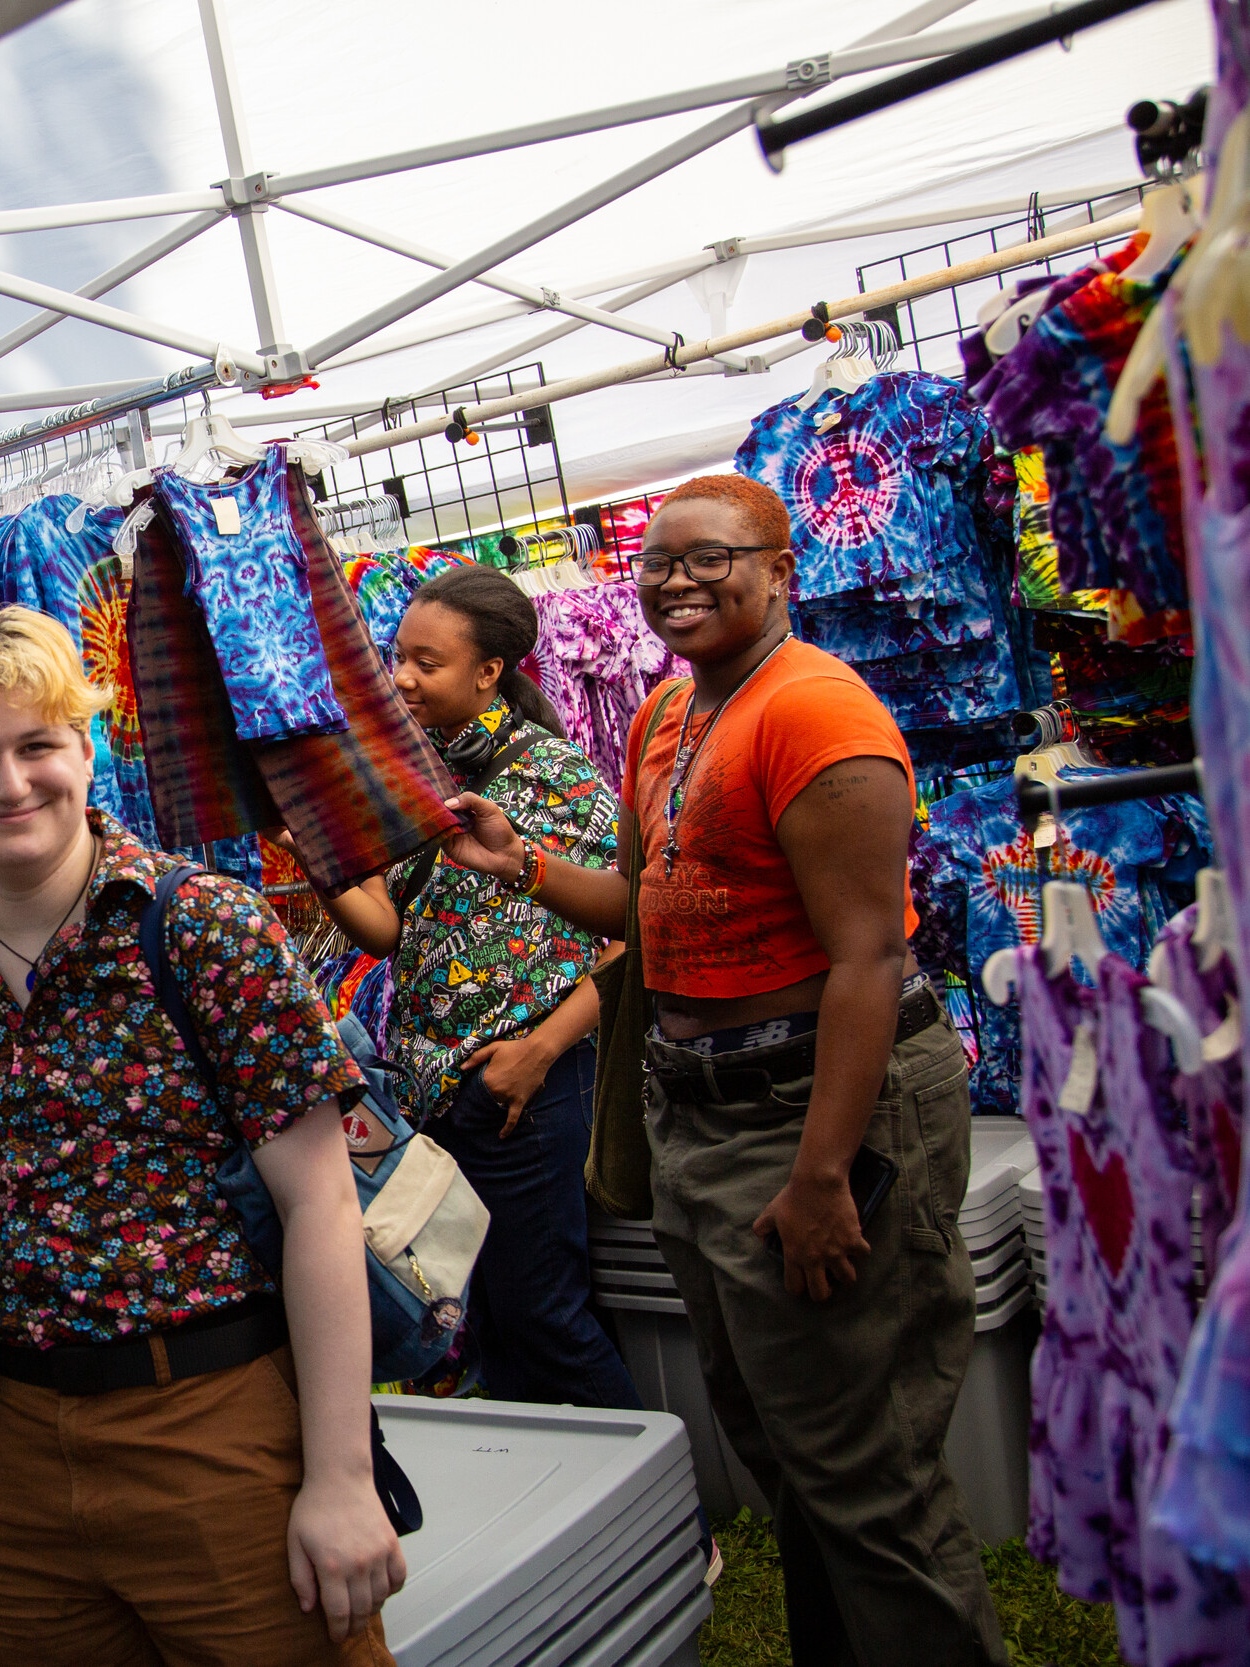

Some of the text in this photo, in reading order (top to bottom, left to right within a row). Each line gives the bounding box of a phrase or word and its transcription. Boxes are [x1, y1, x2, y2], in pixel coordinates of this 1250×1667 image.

[552, 936, 582, 951] Tell Me
[554, 946, 585, 963] More!
[458, 988, 500, 1019] 1997
